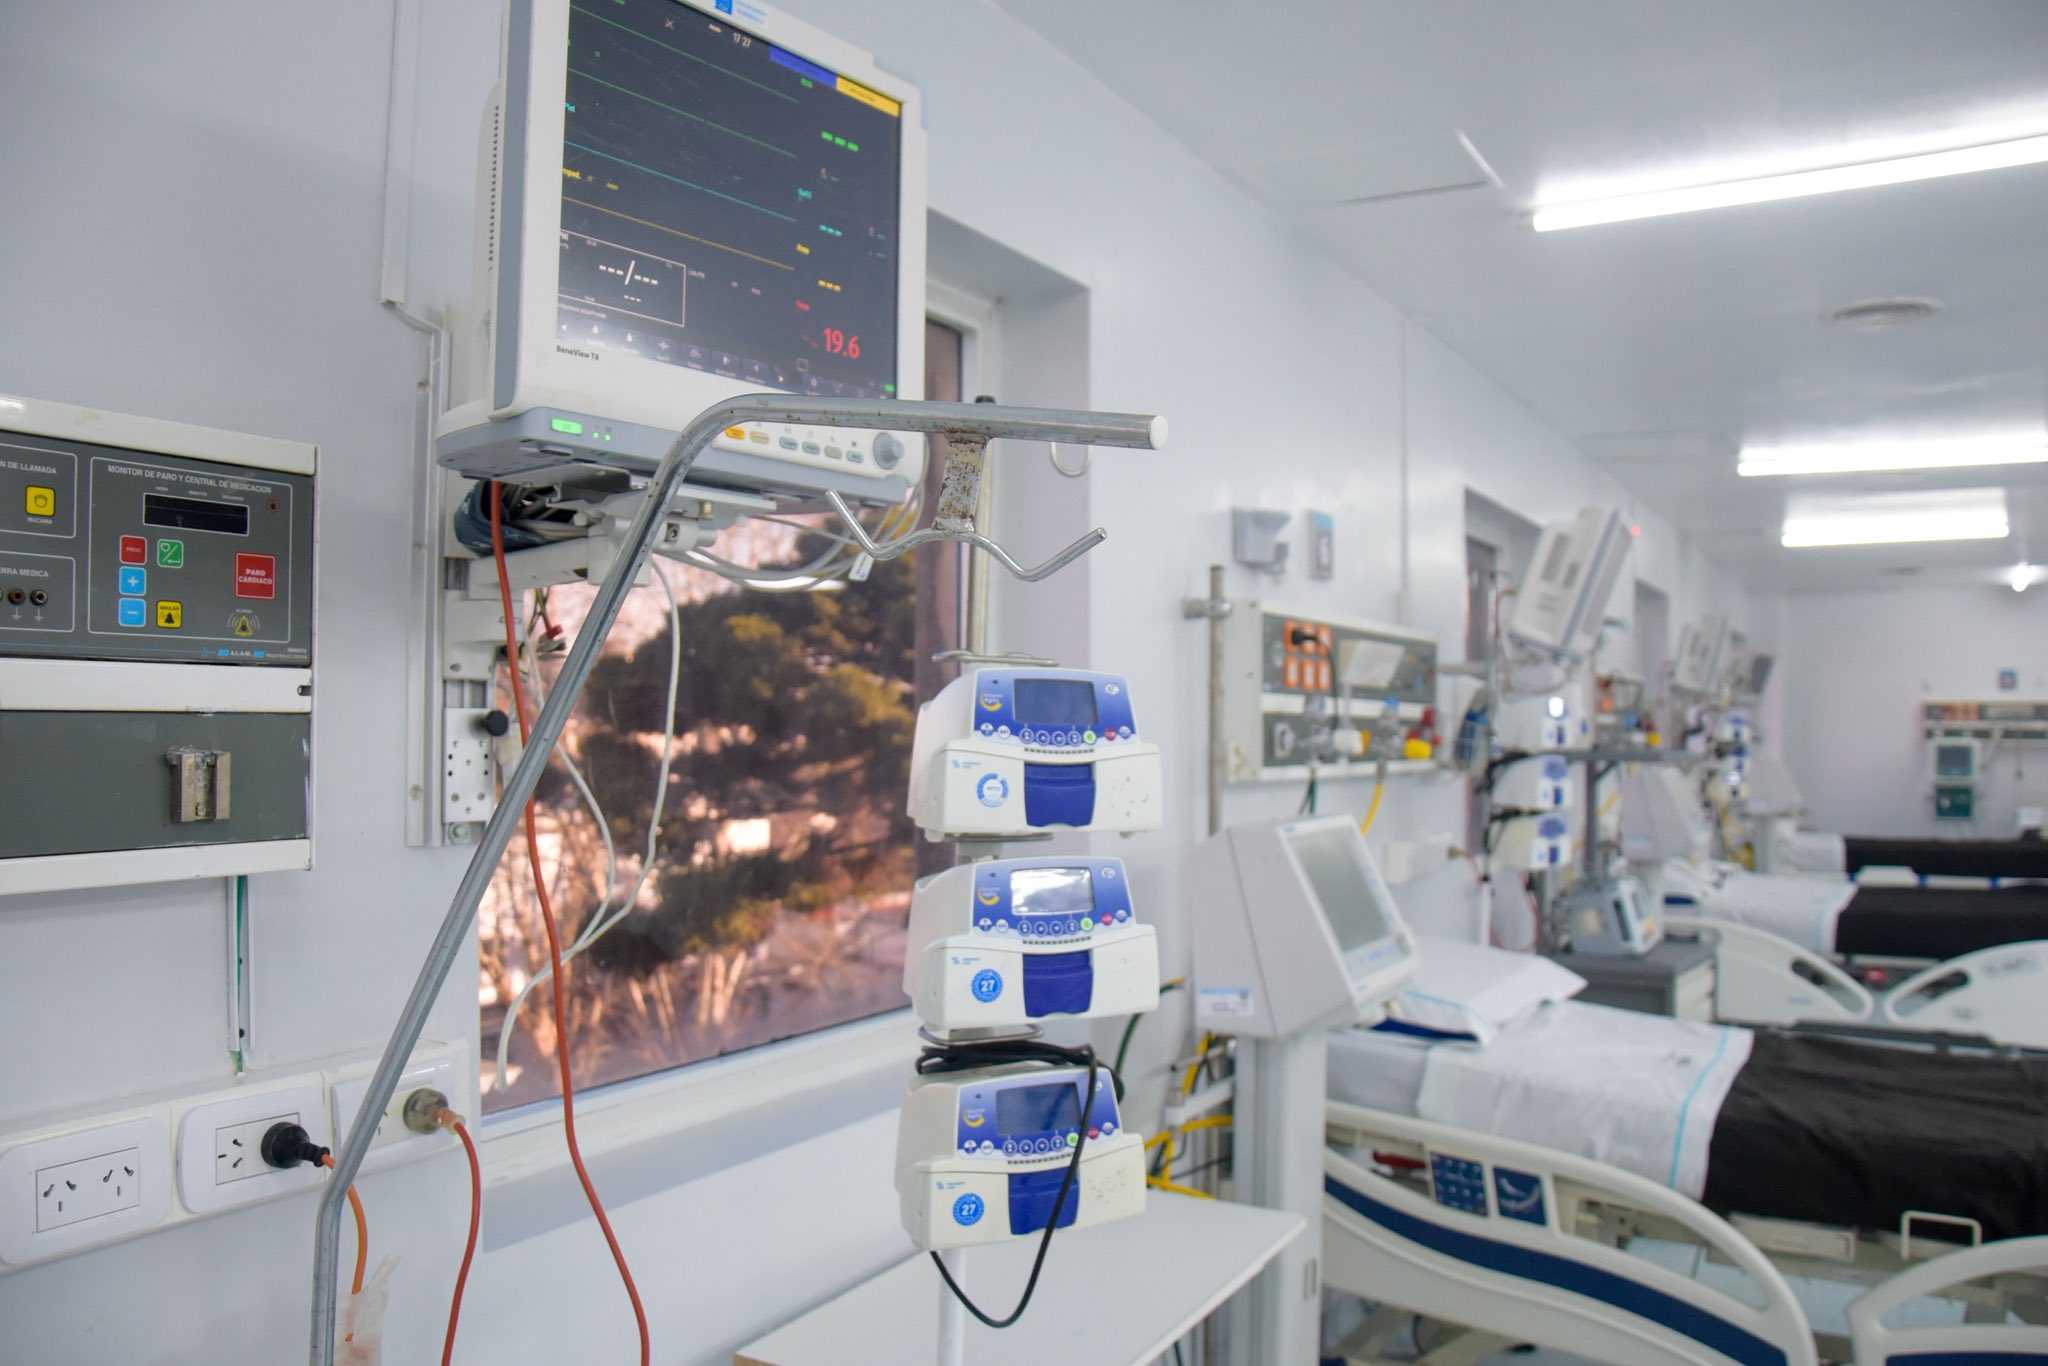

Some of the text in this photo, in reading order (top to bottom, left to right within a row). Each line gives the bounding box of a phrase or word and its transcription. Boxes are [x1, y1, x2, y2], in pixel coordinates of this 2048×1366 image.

[823, 327, 861, 359] 19.6
[556, 344, 590, 359] BeneView
[7, 461, 18, 469] DE
[20, 463, 57, 474] LLAMADA
[107, 464, 143, 476] MONITOR
[144, 469, 155, 479] DE
[156, 471, 177, 481] PARO
[184, 475, 218, 487] CENTRAL
[218, 480, 228, 488] DE
[229, 481, 272, 494] MEDICACION
[19, 568, 49, 577] MEDICA
[245, 568, 266, 577] PARO
[238, 576, 273, 585] CARDIACO
[980, 979, 996, 993] 27
[961, 1203, 977, 1216] 27
